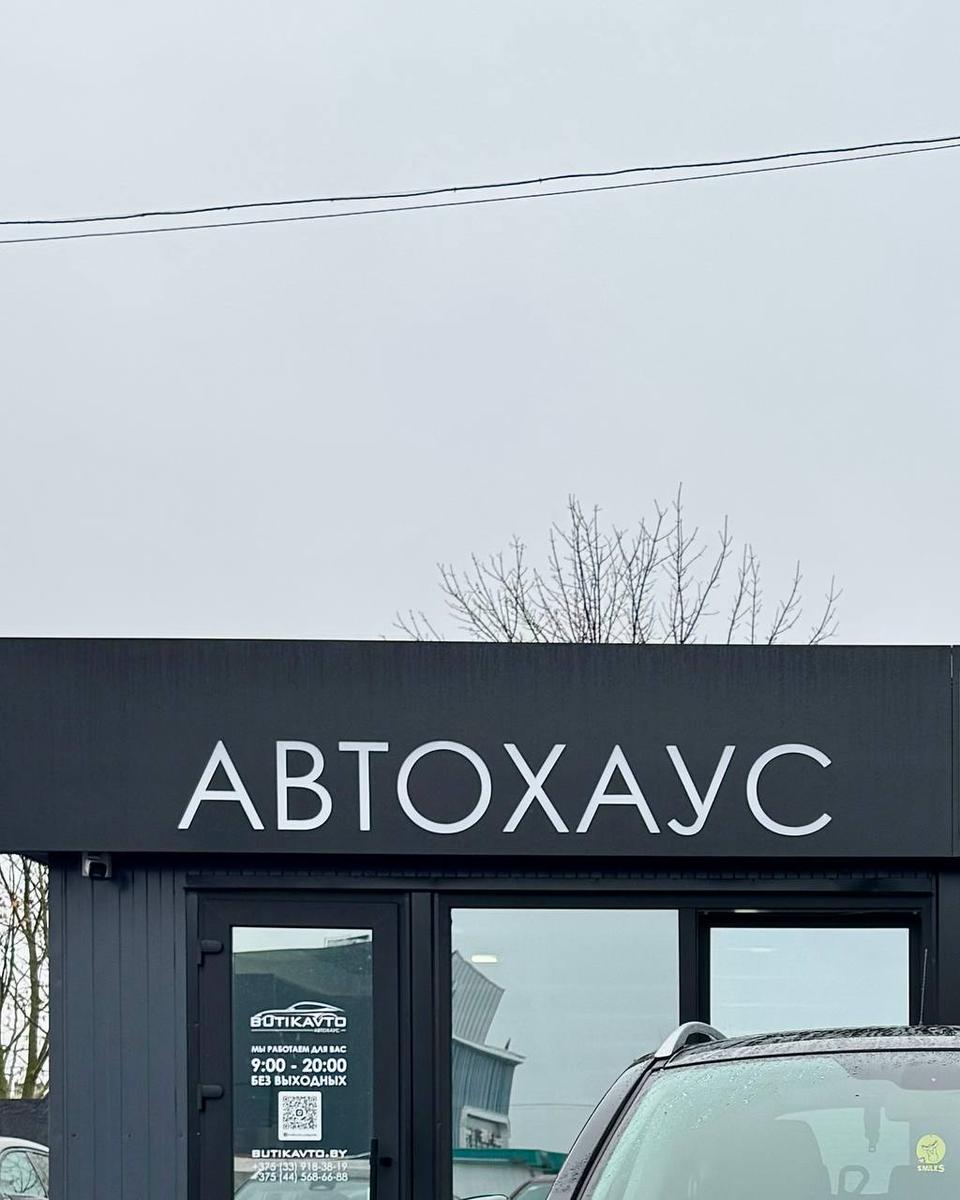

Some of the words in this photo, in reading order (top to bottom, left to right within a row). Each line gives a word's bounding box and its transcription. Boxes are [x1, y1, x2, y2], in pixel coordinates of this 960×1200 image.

[178, 740, 833, 837] АВТОХАУС
[250, 1016, 347, 1028] BUTIKAVTO
[251, 1045, 266, 1053] МЫ
[267, 1045, 310, 1053] РАБОТАЕМ
[311, 1045, 328, 1054] ДЛЯ
[329, 1045, 347, 1053] ВАС
[251, 1058, 286, 1073] 9:00
[302, 1058, 347, 1073] 20:00
[251, 1075, 272, 1086] БЕЗ
[274, 1075, 347, 1088] ВЫХОДНЫХ
[251, 1149, 348, 1158] BUTIKAVTO.BY
[279, 1171, 298, 1183] (44)
[300, 1171, 348, 1181] 568-66-88
